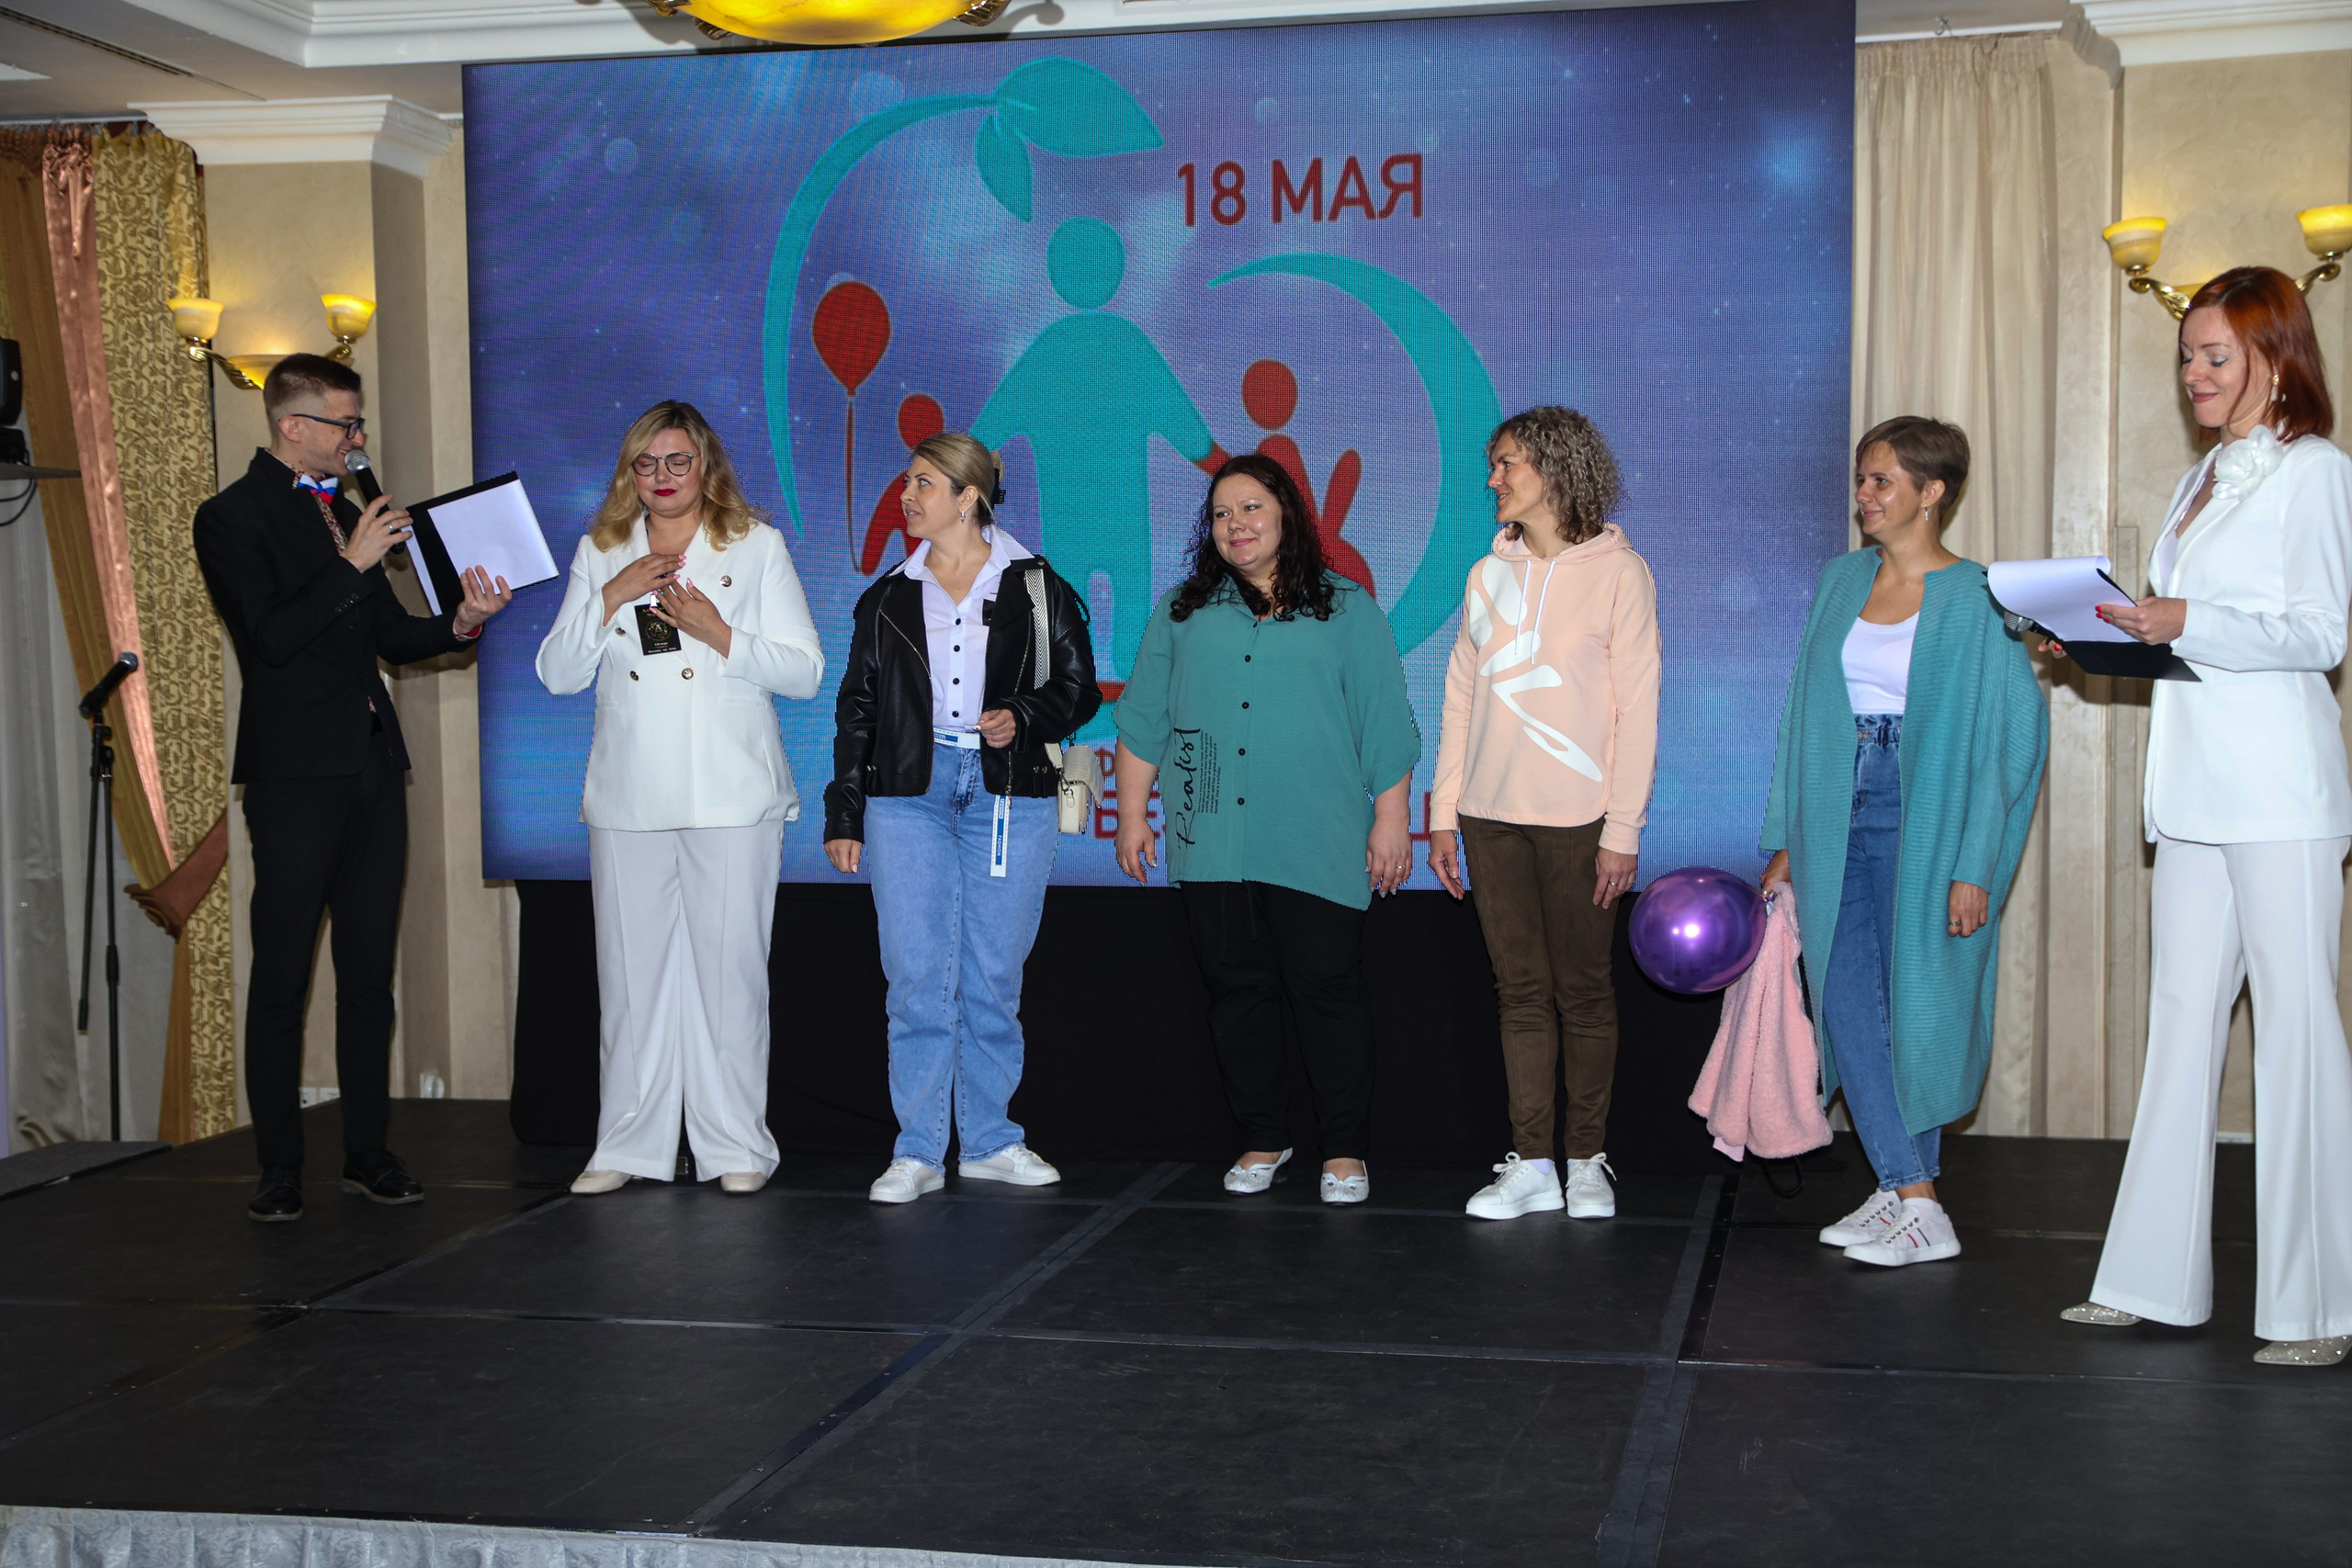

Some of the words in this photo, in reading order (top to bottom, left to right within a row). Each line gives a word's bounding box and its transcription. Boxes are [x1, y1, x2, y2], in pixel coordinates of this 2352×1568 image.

[1177, 160, 1247, 228] 18
[1271, 152, 1423, 224] МАЯ
[1173, 728, 1201, 850] Realist
